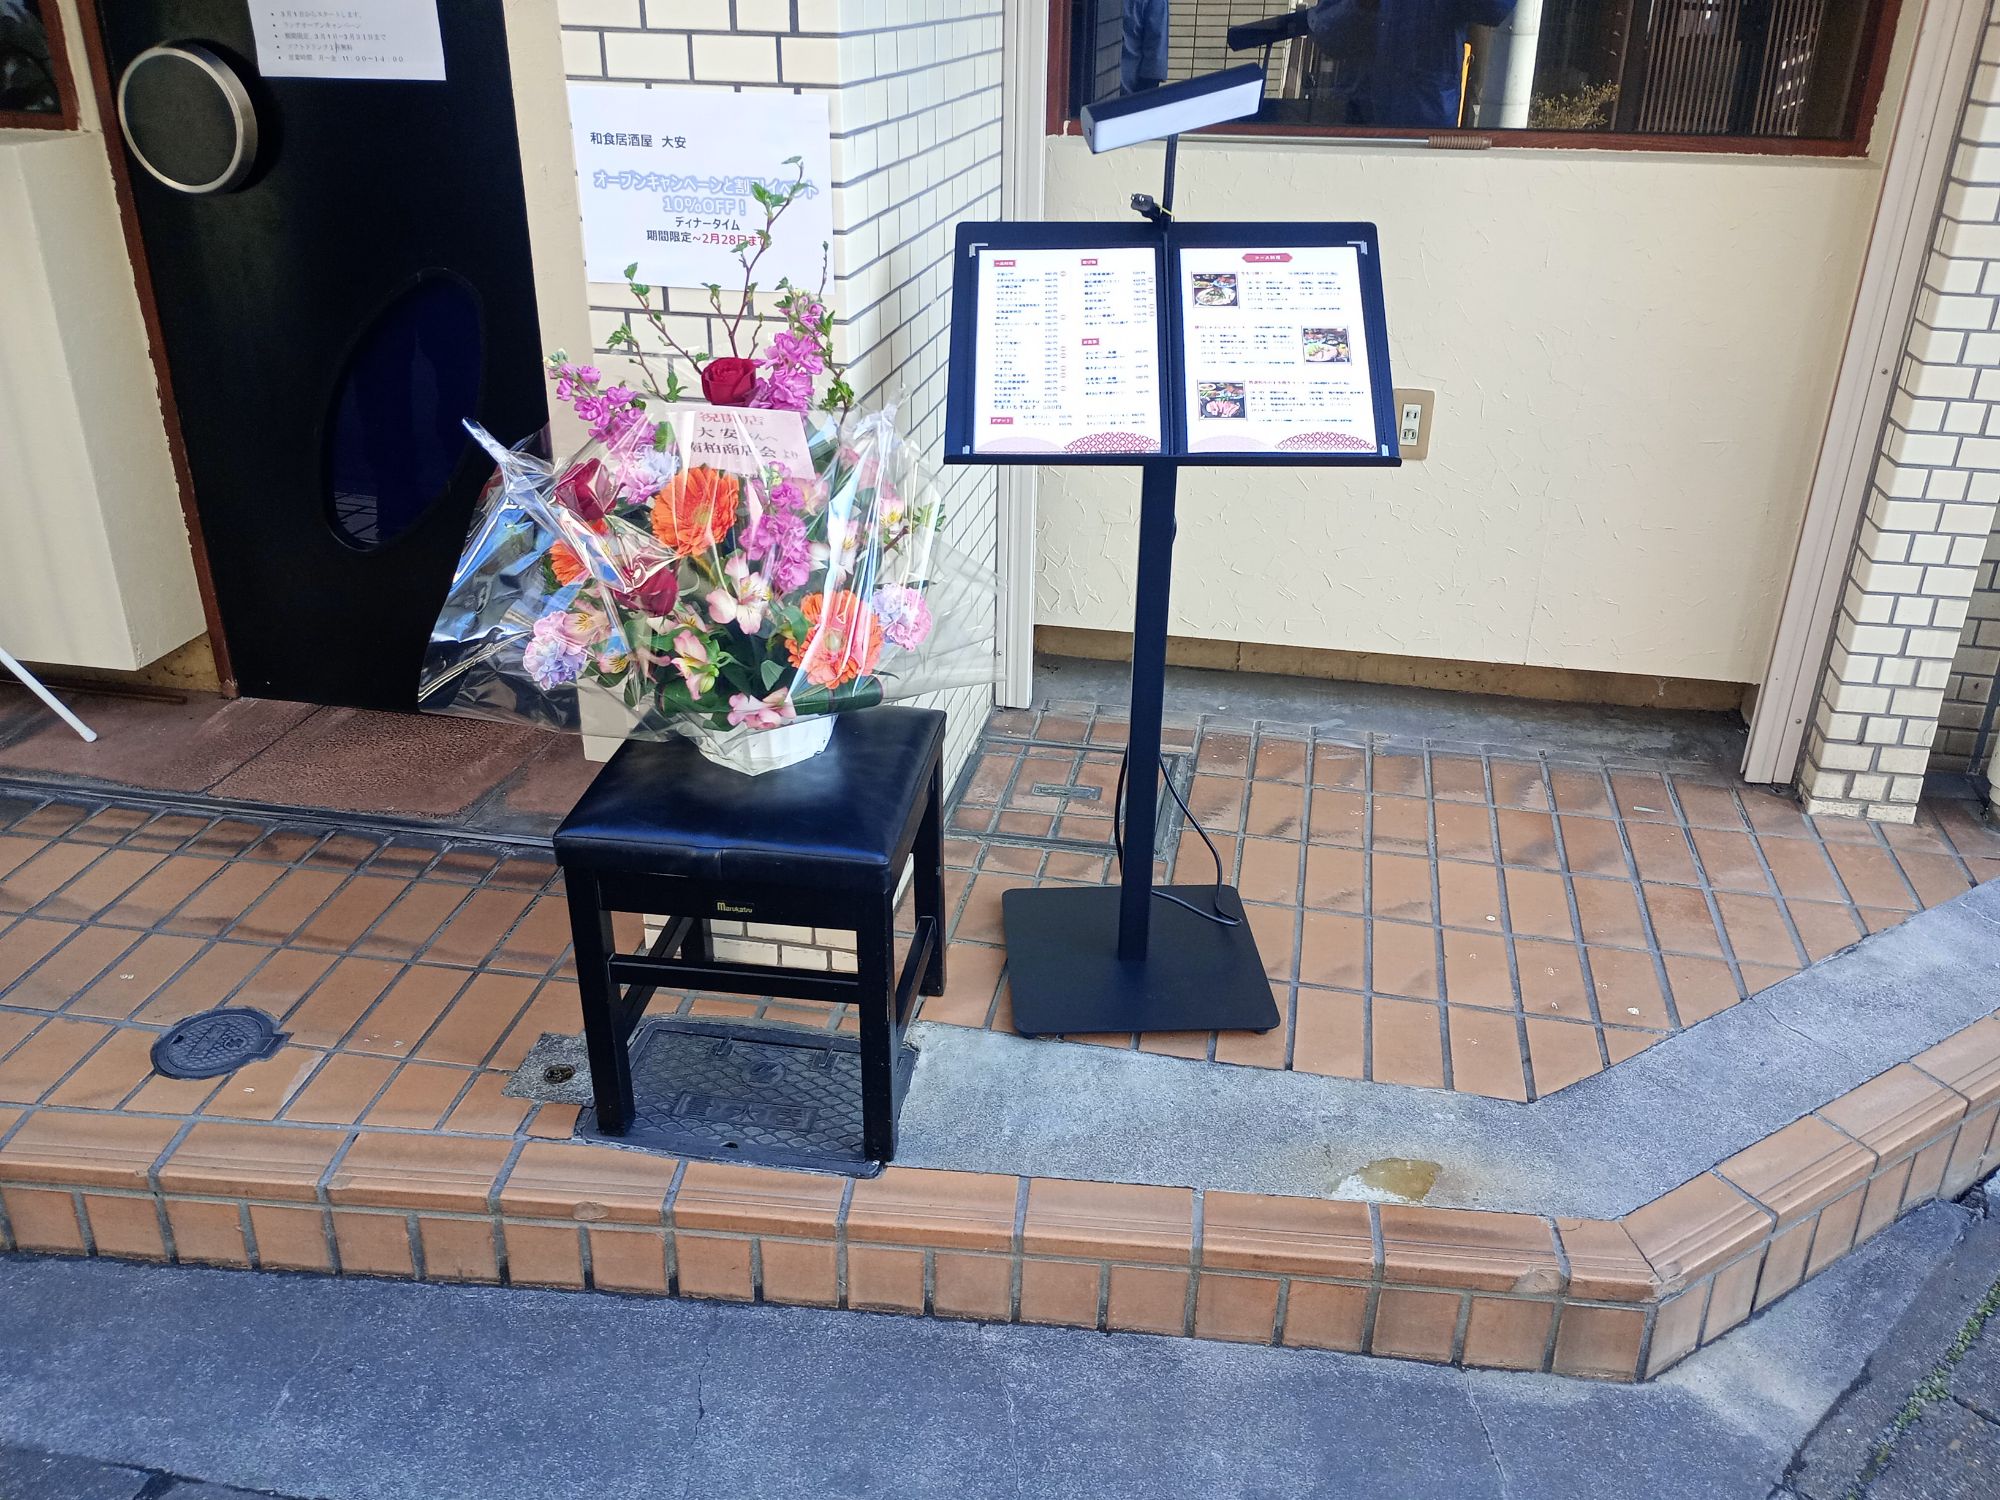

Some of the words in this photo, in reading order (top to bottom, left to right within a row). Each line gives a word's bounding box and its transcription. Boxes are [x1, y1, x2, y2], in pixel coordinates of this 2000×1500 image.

[590, 132, 653, 148] 和食居酒屋
[661, 135, 687, 149] 大安
[675, 217, 741, 231] ディナータイム
